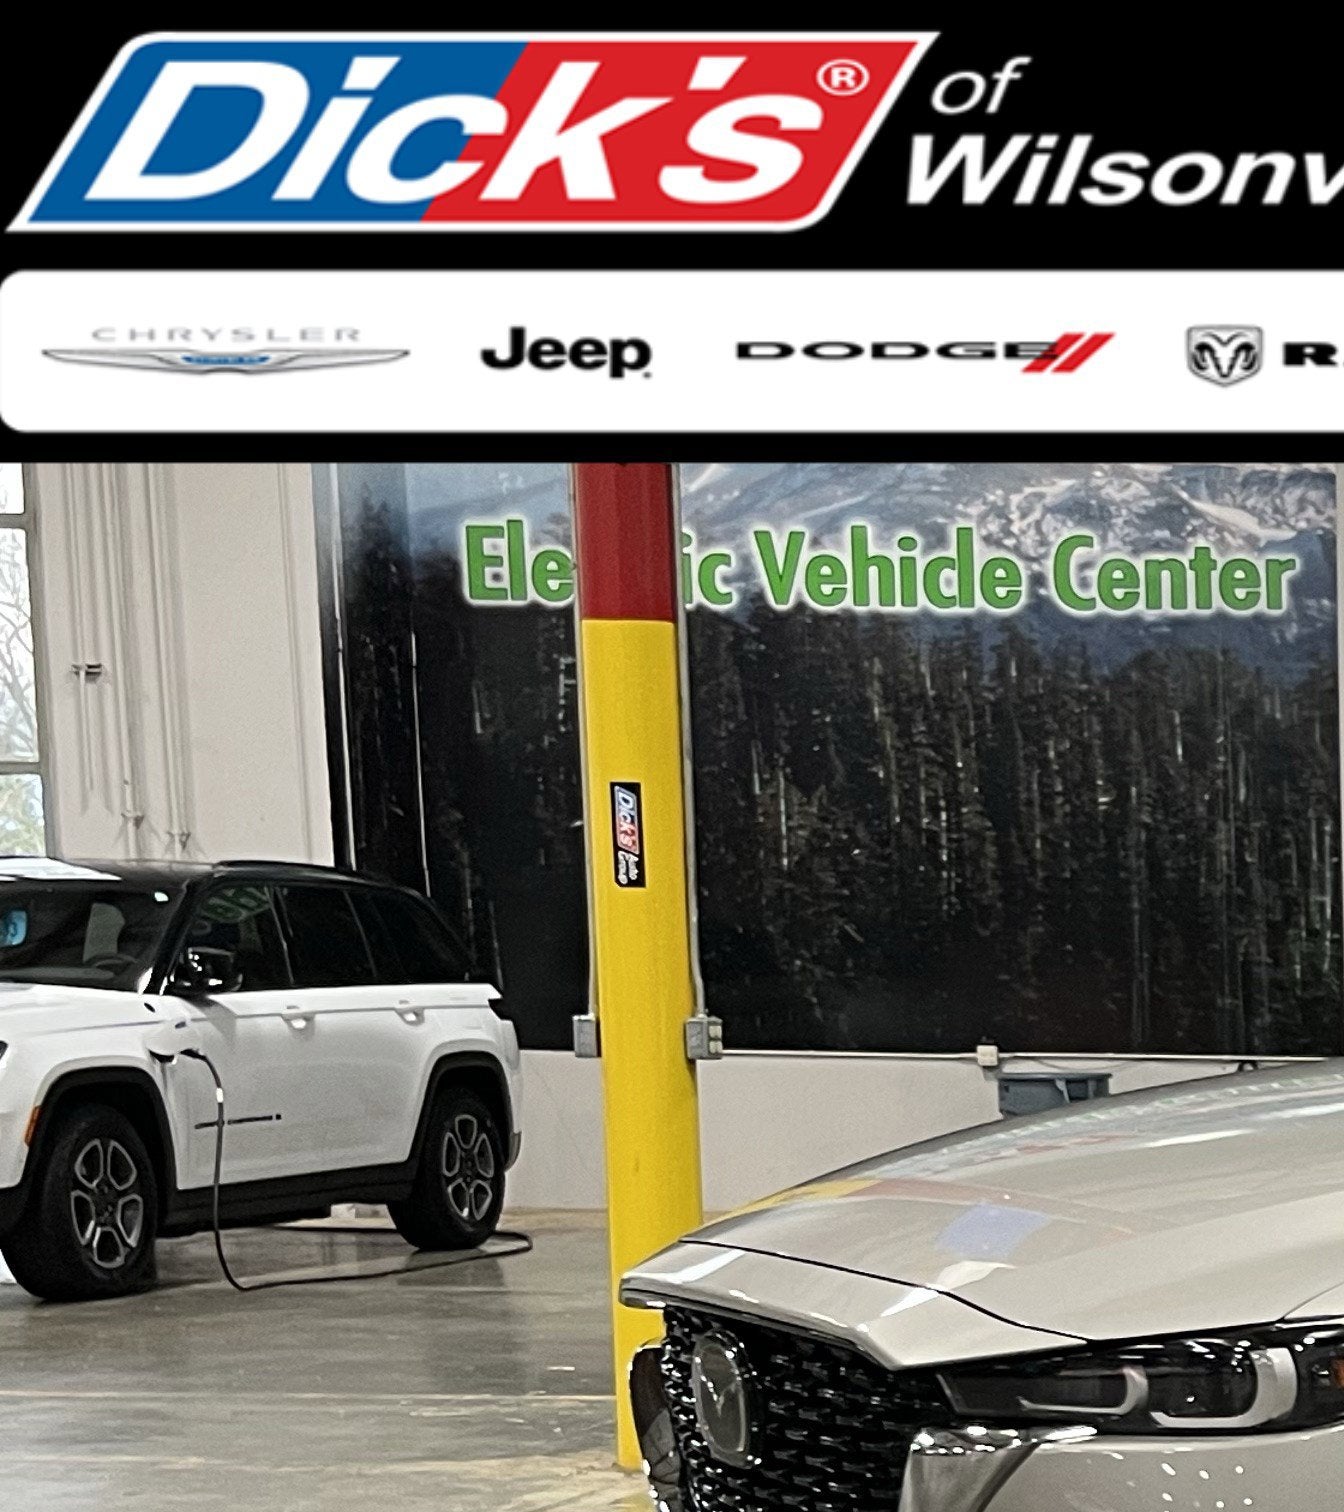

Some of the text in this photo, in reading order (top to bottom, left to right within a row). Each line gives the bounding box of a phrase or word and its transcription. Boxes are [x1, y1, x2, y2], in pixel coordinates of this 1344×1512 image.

[465, 519, 1297, 611] Eleic Vehicle Center
